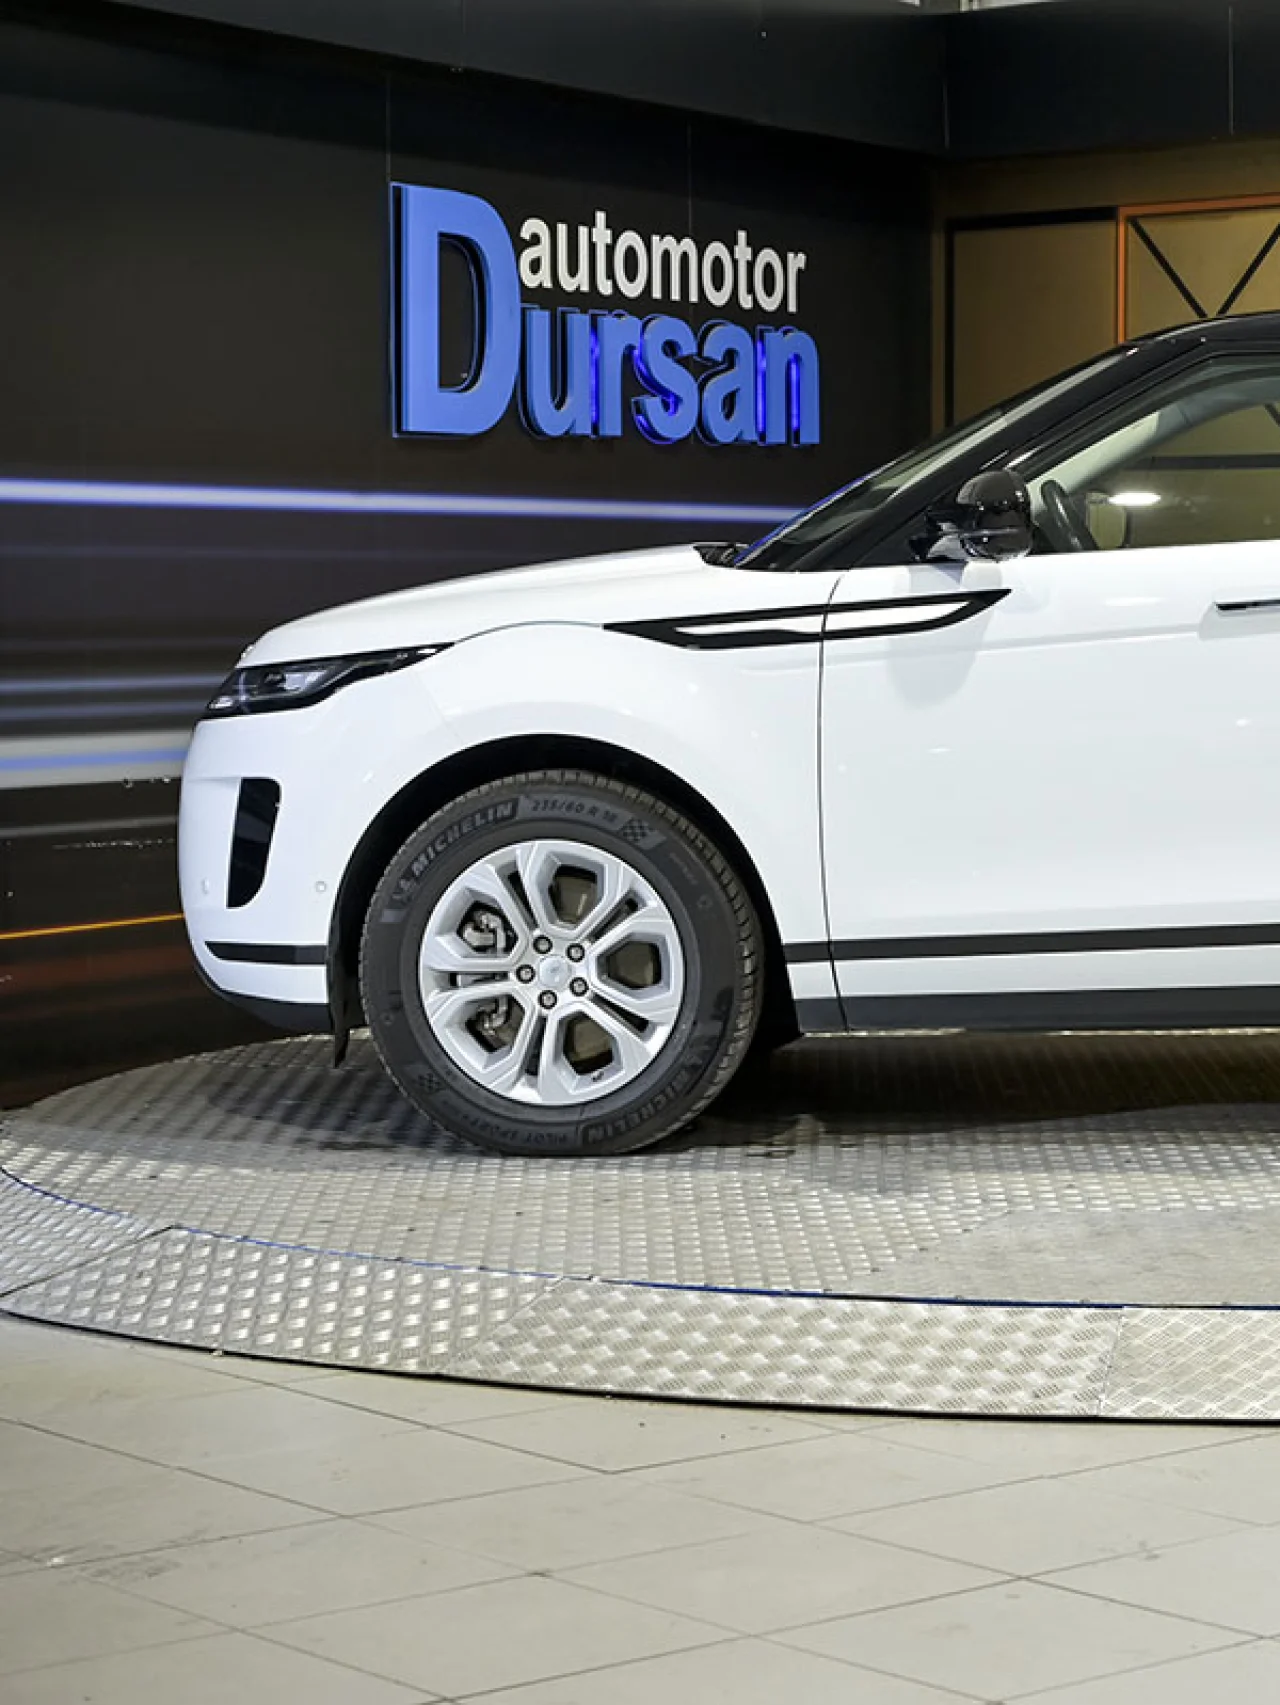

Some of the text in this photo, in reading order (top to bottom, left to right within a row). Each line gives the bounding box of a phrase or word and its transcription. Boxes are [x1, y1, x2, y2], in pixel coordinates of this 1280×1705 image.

[519, 210, 806, 313] automotor
[389, 180, 820, 447] Dursan
[410, 801, 515, 879] MICHELIN
